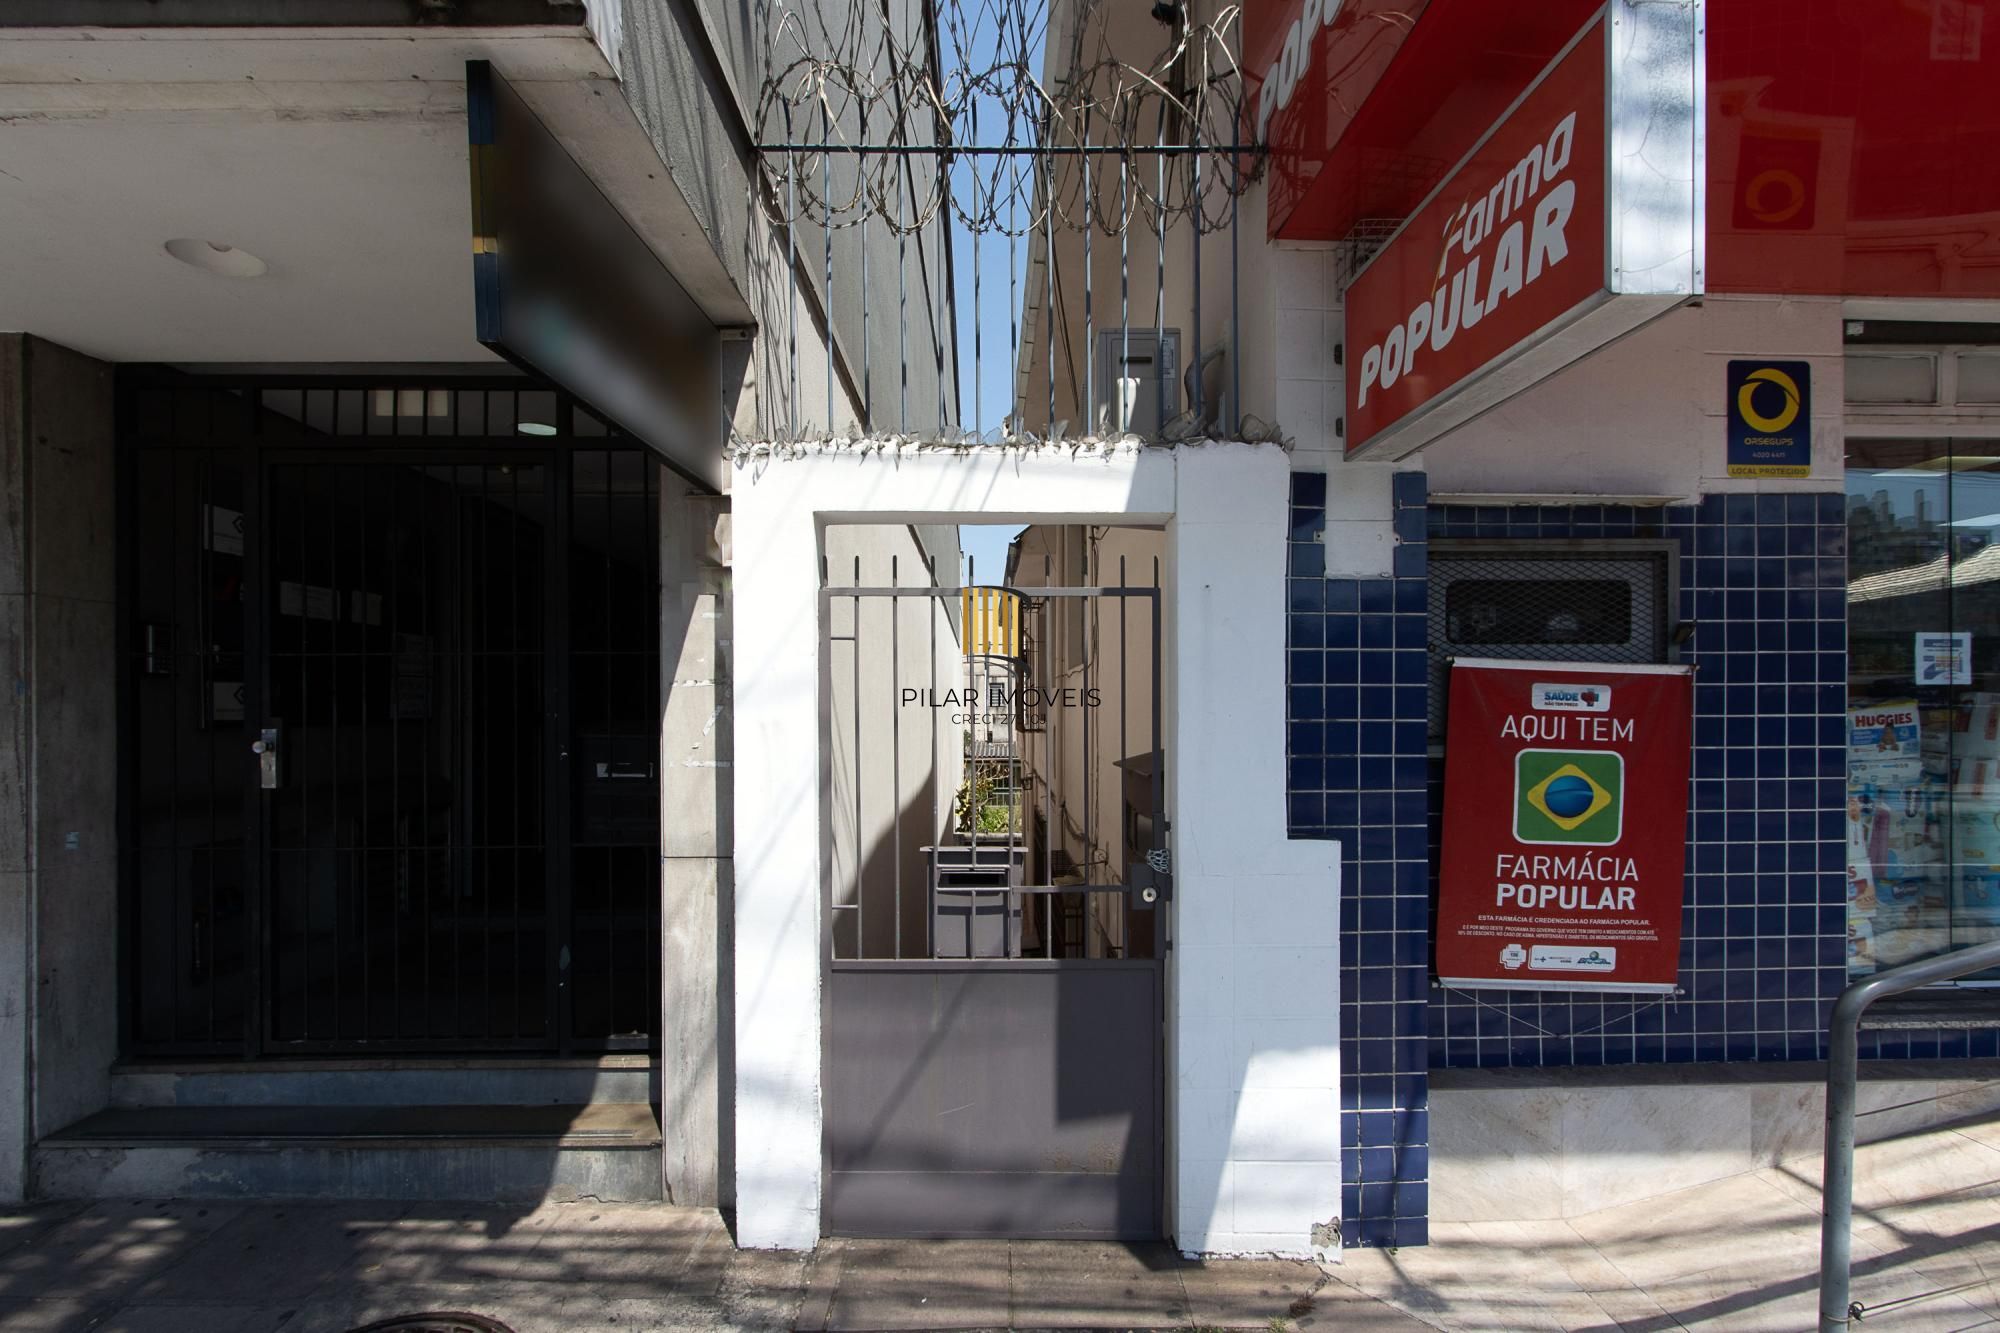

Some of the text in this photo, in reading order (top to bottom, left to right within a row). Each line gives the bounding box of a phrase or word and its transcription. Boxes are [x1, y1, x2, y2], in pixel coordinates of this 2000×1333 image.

[1257, 0, 1344, 146] POP
[1439, 111, 1576, 279] Farma
[1357, 179, 1576, 410] POPULAR
[1744, 437, 1794, 446] ORSEGUPS
[1731, 467, 1807, 475] LOCAL PROTEGIDO
[1544, 690, 1579, 702] SAÚDE
[1500, 715, 1635, 742] AQUI TEM
[1854, 712, 1913, 728] HUGGIES
[1496, 850, 1640, 882] FARMÁCIA
[1496, 883, 1636, 910] POPULAR
[1534, 916, 1578, 924] CREDENCIADA
